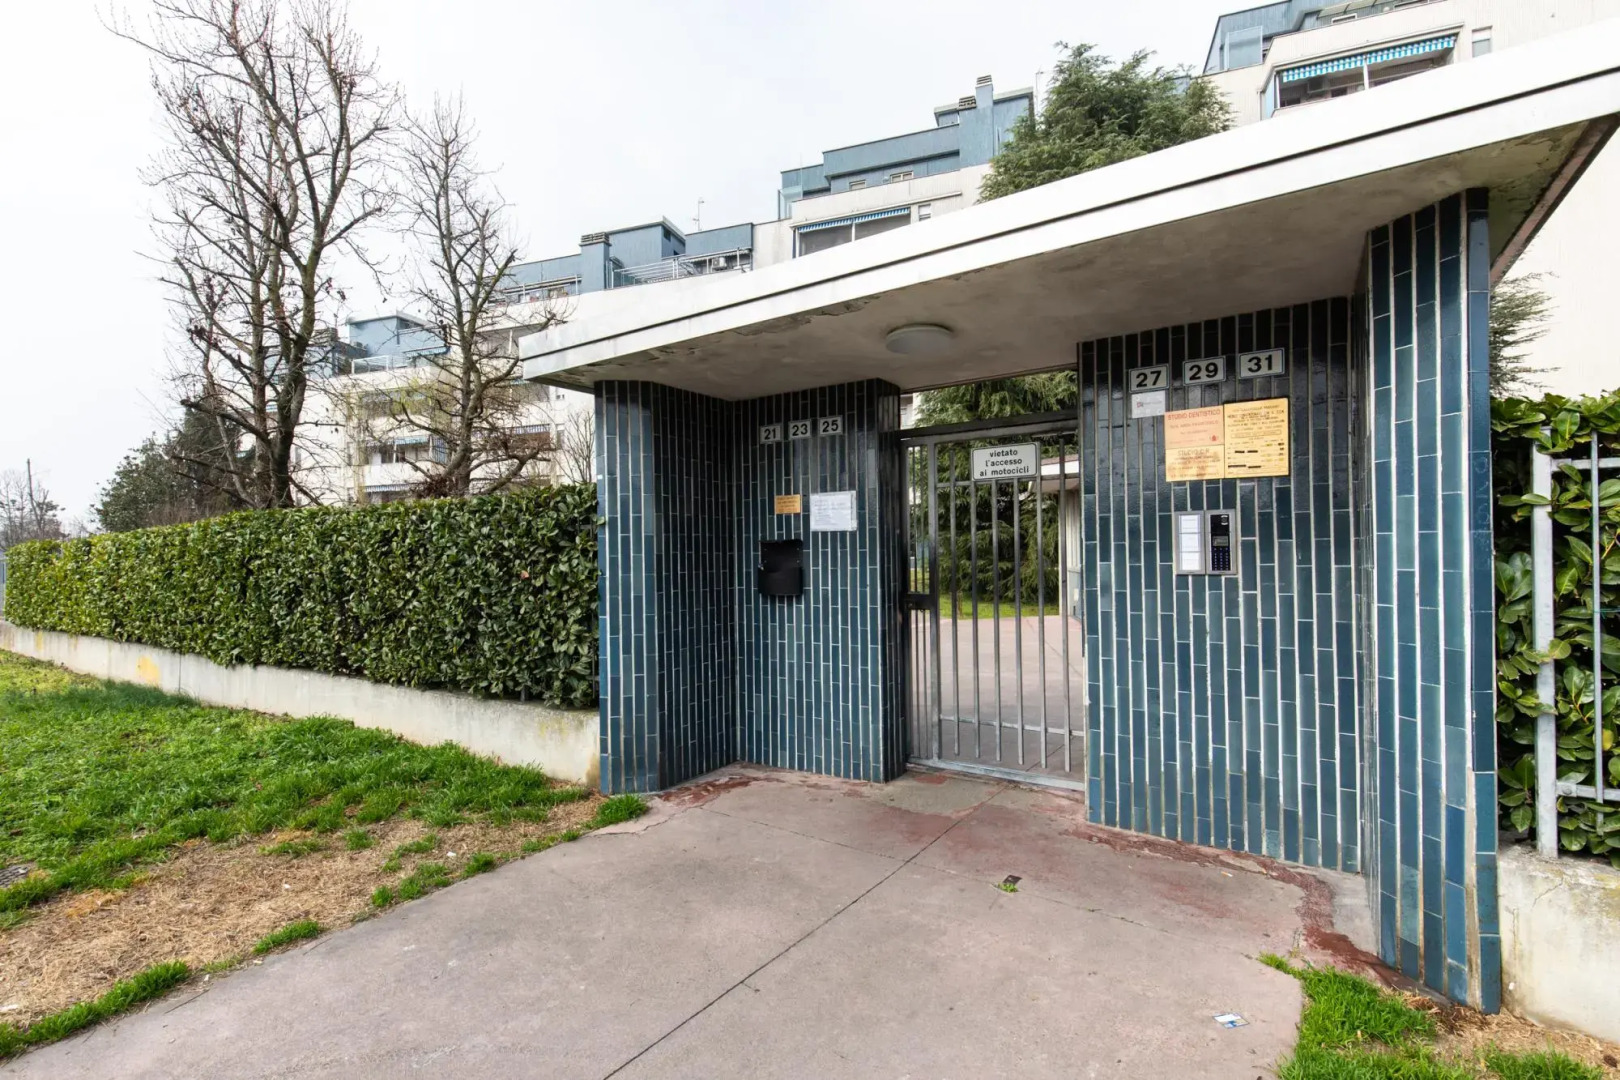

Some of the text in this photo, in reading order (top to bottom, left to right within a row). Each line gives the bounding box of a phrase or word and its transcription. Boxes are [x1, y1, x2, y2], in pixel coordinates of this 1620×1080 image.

[1247, 354, 1273, 373] 31
[1188, 362, 1219, 381] 29
[1135, 370, 1162, 388] 27
[1167, 412, 1188, 420] STUDIO
[1189, 408, 1221, 418] DENTISTICO
[791, 423, 808, 437] 23
[822, 419, 839, 433] 25
[764, 428, 776, 440] 21
[989, 448, 1018, 457] vietato
[985, 458, 1023, 467] l'accesso
[979, 465, 1029, 477] ai motocicli
